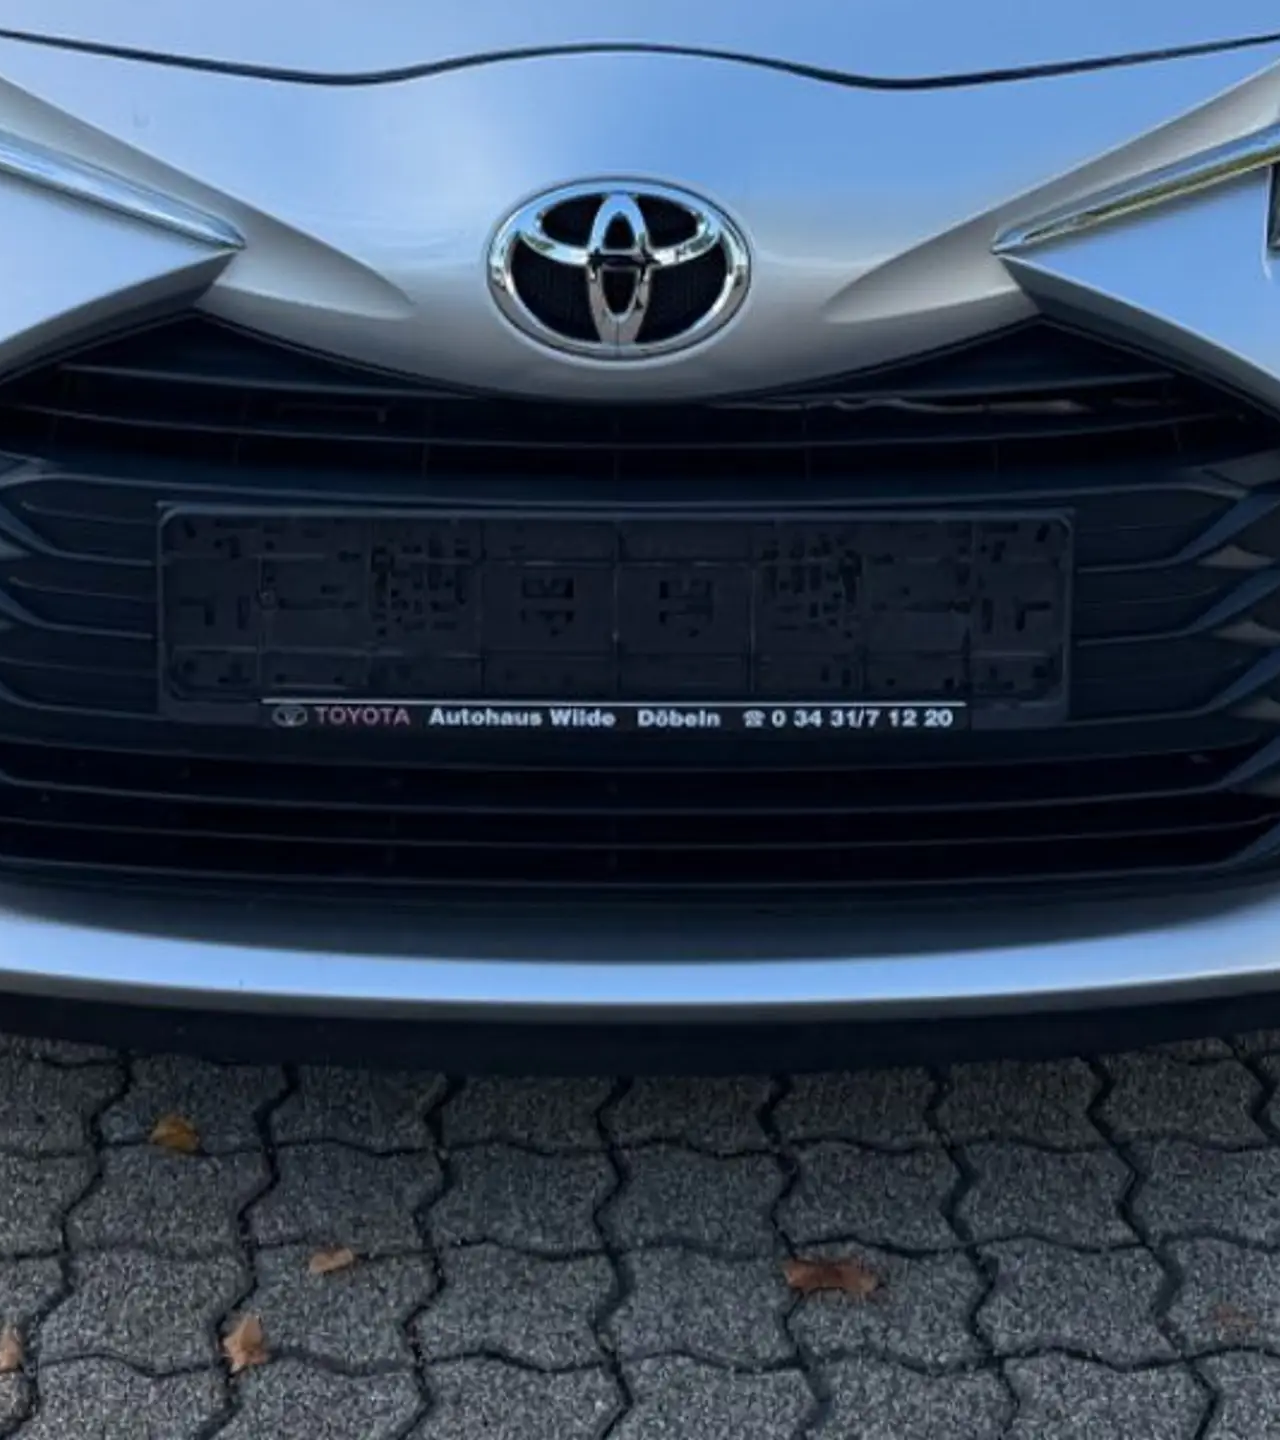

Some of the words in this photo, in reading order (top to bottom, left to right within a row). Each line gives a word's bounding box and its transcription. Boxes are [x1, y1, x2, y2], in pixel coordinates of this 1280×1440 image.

[314, 706, 411, 725] TOYOTA
[428, 706, 543, 727] Autohaus
[549, 707, 617, 728] Wilde
[637, 707, 721, 728] Döbeln
[771, 708, 787, 728] 0
[793, 708, 824, 728] 34
[829, 708, 881, 729] 31/7
[888, 708, 919, 728] 12
[923, 708, 955, 728] 20
